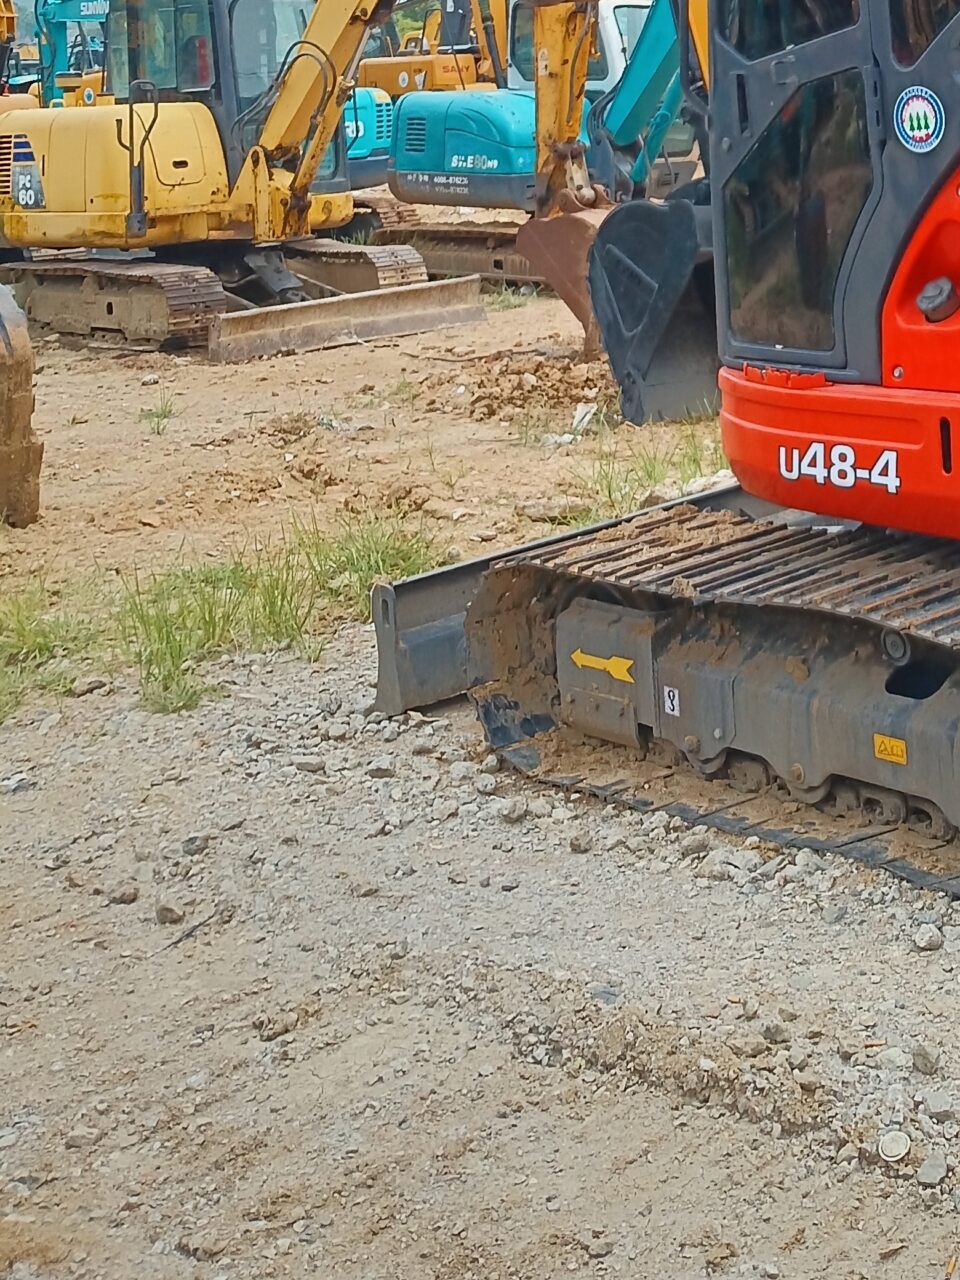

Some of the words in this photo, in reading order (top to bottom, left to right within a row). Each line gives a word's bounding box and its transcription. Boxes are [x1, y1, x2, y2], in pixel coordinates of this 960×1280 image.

[442, 65, 470, 73] SANY
[18, 174, 31, 189] PC
[18, 189, 35, 205] 60
[779, 441, 901, 495] U48-4
